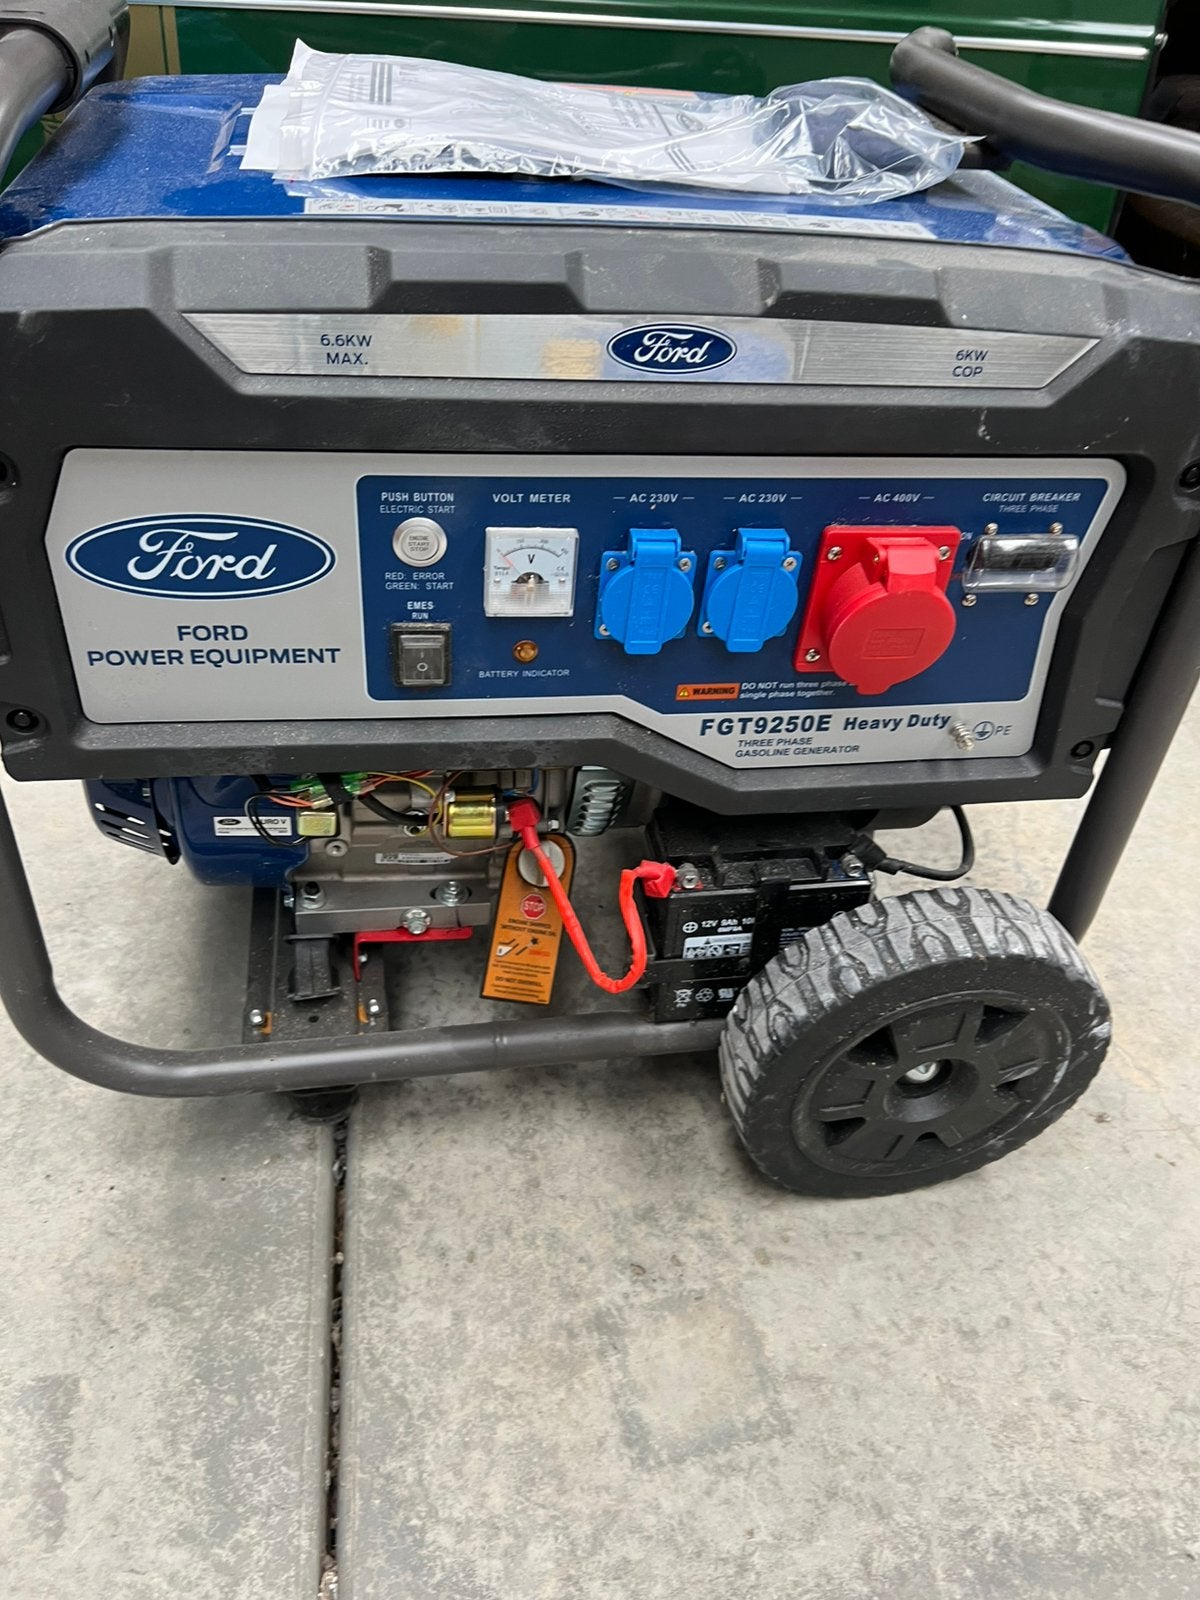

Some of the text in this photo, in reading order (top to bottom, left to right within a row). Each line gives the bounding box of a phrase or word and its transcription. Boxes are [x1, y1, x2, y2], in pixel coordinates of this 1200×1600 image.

[320, 334, 372, 347] 6.6KW
[634, 331, 714, 363] Ford
[326, 352, 369, 365] MAX.
[955, 349, 989, 361] 6KW
[952, 365, 984, 377] COP
[381, 492, 454, 502] PUSH BUTTON
[492, 493, 571, 503] VOLT METER
[629, 493, 678, 503] AC 230V
[738, 493, 787, 503] AC 230V
[874, 493, 921, 503] AC 400V
[982, 493, 1081, 502] CIRCUIT BREAKER
[380, 504, 456, 514] ELECTRIC START
[999, 504, 1060, 513] THREE PHASE
[127, 528, 277, 580] Ford
[527, 554, 535, 564] V
[384, 572, 445, 581] RED: ERROR
[385, 582, 454, 590] GREEN: START
[407, 601, 434, 610] EMES
[411, 612, 429, 620] RUN
[176, 625, 248, 641] FORD
[87, 648, 341, 667] POWER EQUIPMENT
[479, 669, 570, 679] BATTERY INDICATOR
[741, 682, 756, 690] DO
[821, 680, 846, 688] phase
[692, 687, 736, 696] WARNING
[739, 689, 836, 700] single phase together.
[700, 714, 952, 736] FGT9250E Heavy Duty
[995, 725, 1012, 735] PE
[738, 737, 813, 748] THREE PHASE
[735, 745, 860, 758] GASOLINE GENERATOR
[524, 901, 544, 911] STOP
[701, 920, 718, 928] 12V
